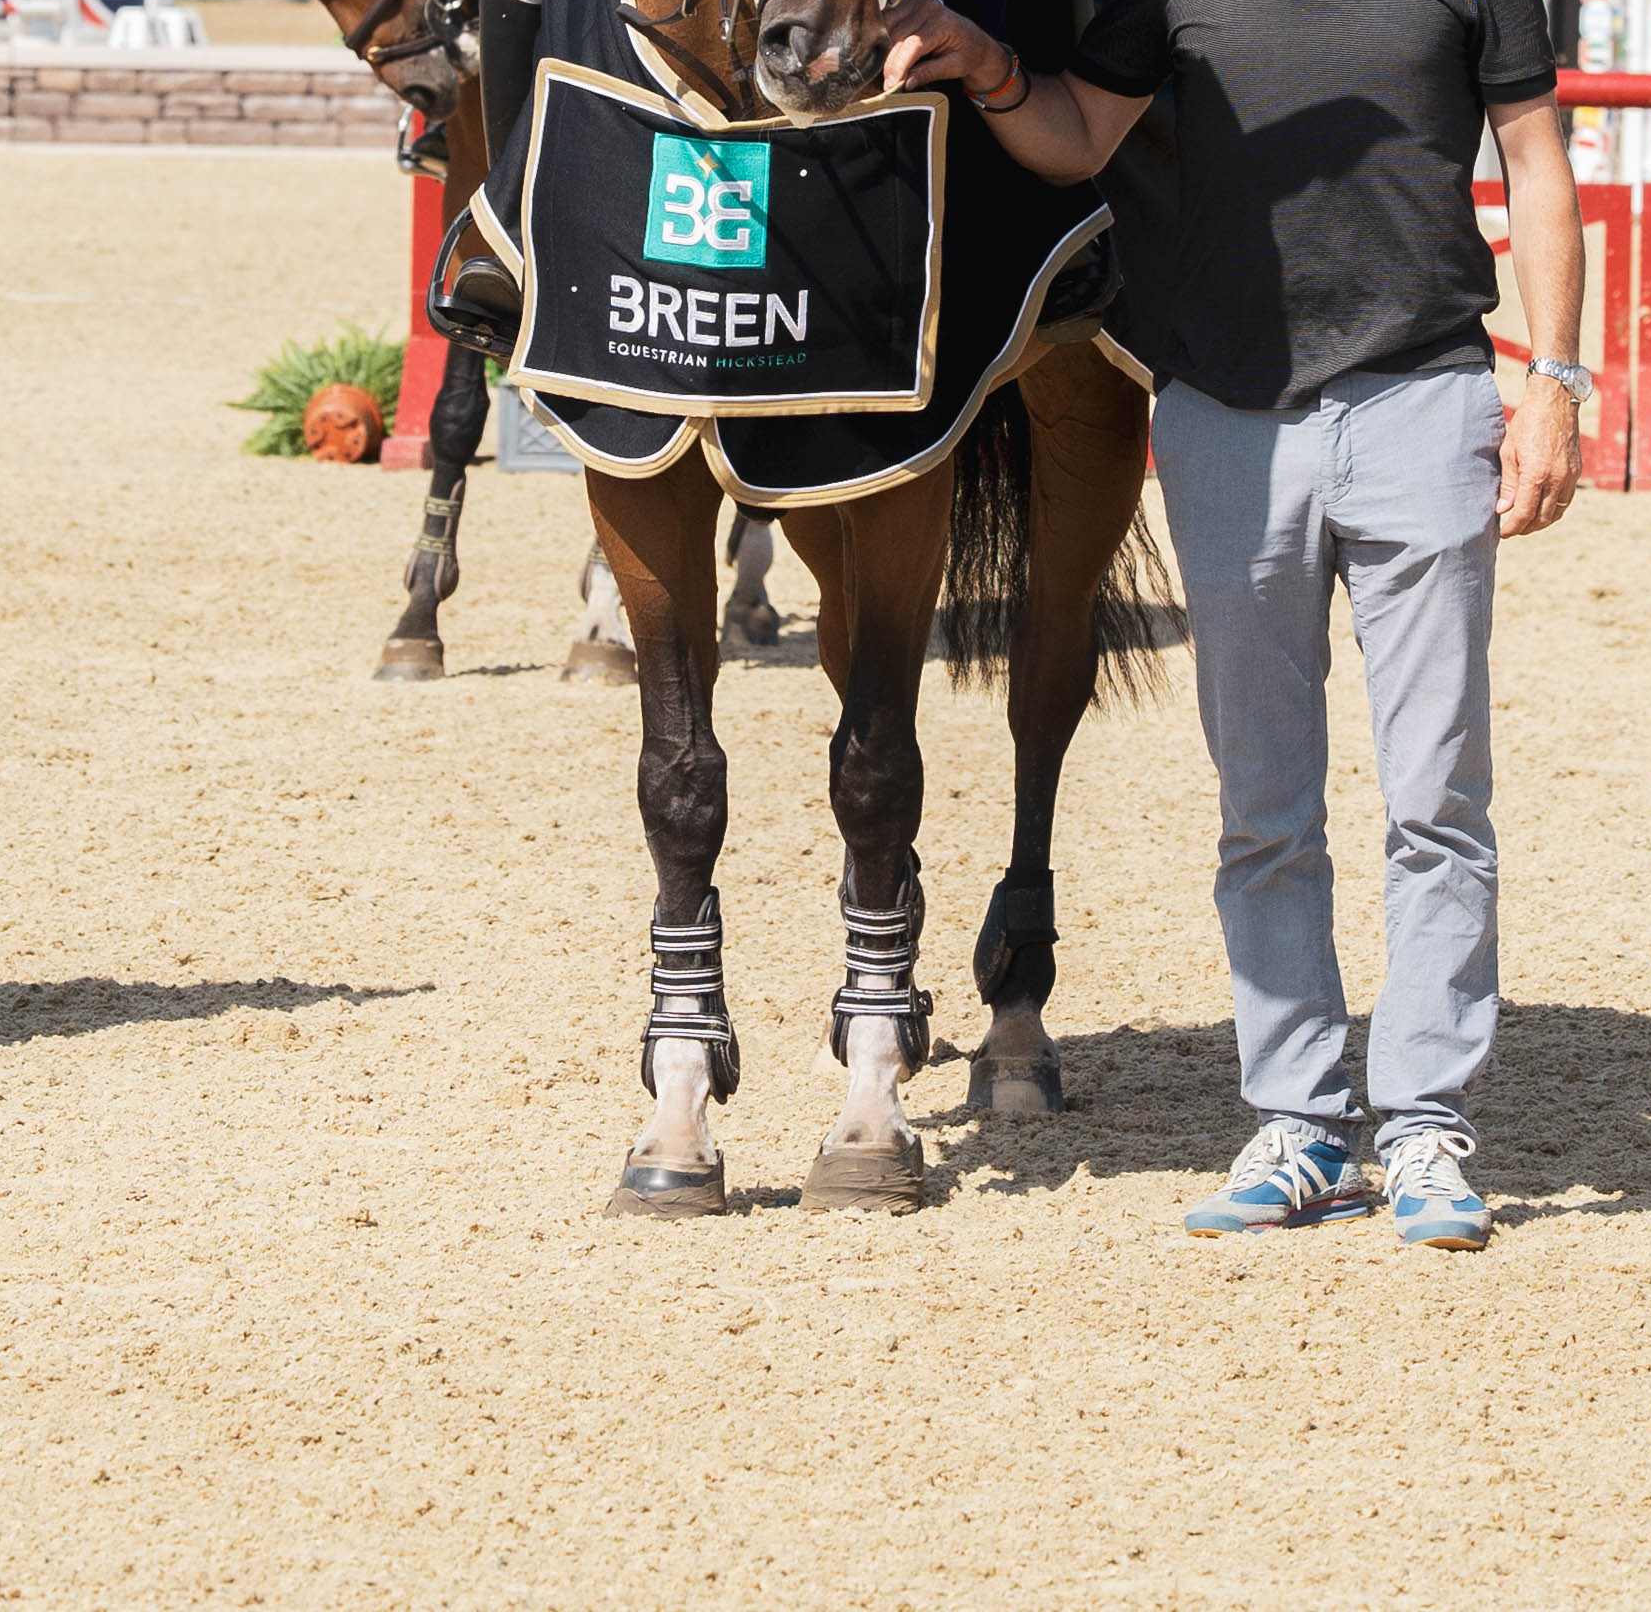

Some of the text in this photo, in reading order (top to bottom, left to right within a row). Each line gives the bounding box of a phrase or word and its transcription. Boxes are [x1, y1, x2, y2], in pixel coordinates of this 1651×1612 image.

[608, 274, 809, 348] BREEN
[608, 340, 807, 368] EQUESTRIAN HICKSTEAD
